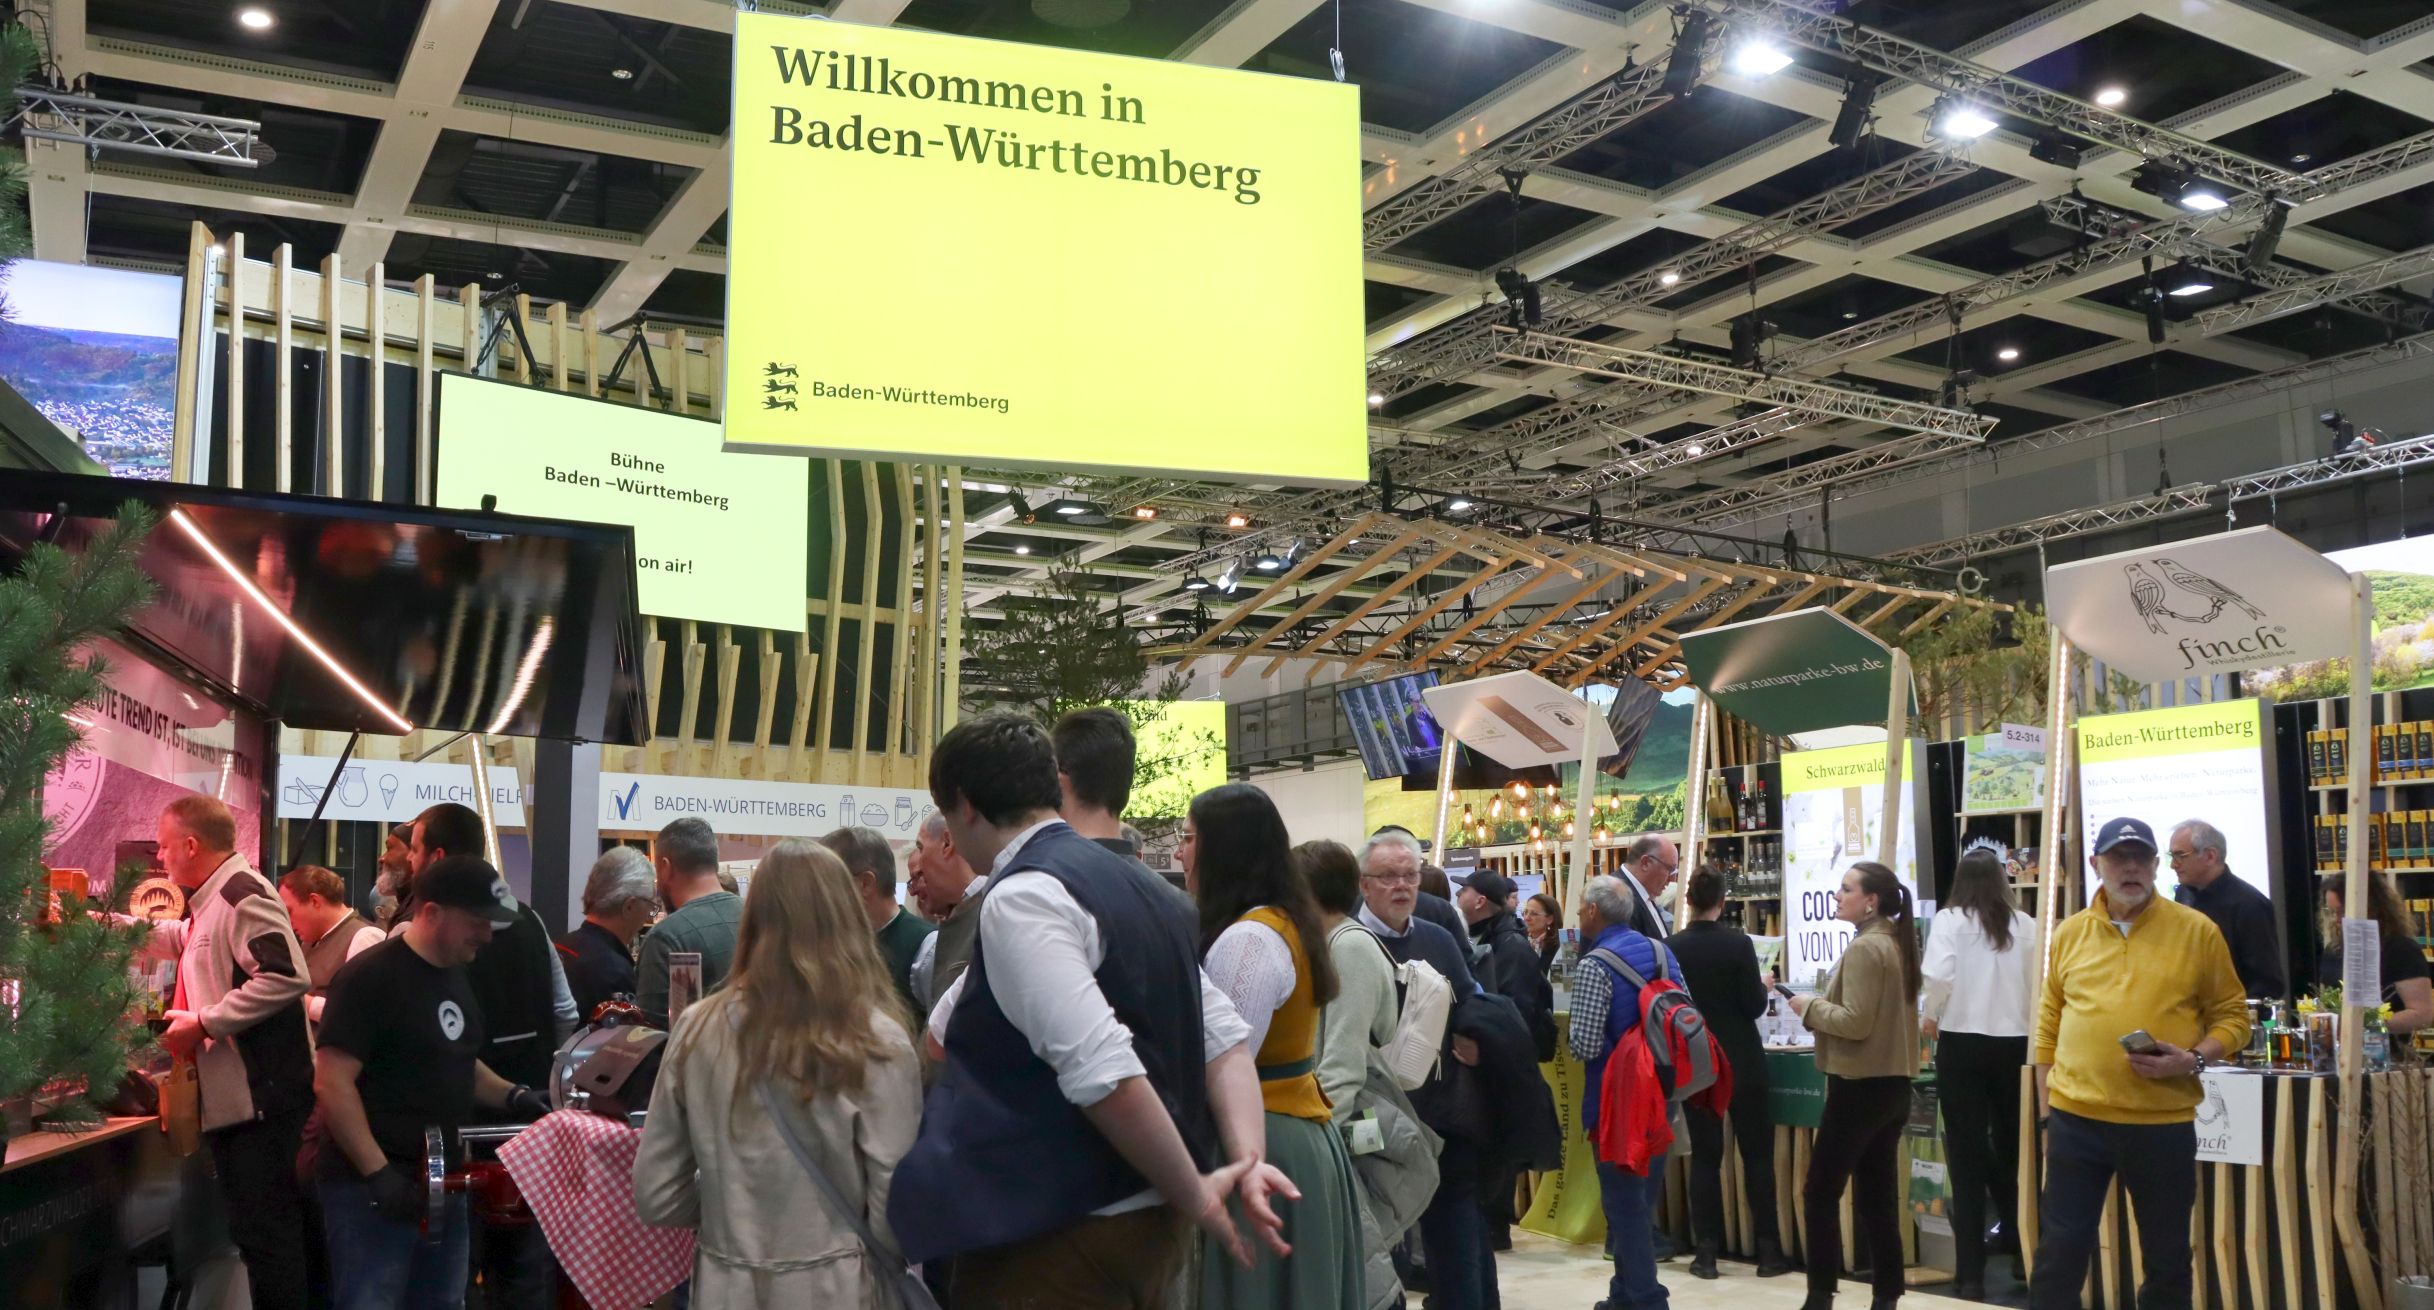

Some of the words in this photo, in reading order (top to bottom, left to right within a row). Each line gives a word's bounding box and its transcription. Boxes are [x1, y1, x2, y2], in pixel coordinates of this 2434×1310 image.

[771, 45, 1087, 118] Willkommen
[1099, 83, 1147, 125] in
[769, 105, 1262, 205] Baden-Württemberg
[812, 381, 1010, 414] Baden-Württemberg
[544, 466, 600, 488] Baden
[610, 452, 665, 473] Bühne
[638, 557, 660, 570] on
[664, 558, 693, 574] air!
[1715, 657, 1885, 696] www.naturparke-bw.de
[120, 692, 153, 735] TREND
[153, 709, 171, 750] IST,
[172, 719, 186, 751] IST
[2085, 720, 2254, 749] Baden-Württemberg
[2007, 730, 2041, 743] 5.2-314
[1806, 758, 1886, 779] Schwarzwald
[654, 795, 827, 818] BADEN-WÜRTTEMBERG
[1803, 890, 1836, 921] COC
[1799, 931, 1833, 962] VON
[1547, 1193, 1561, 1219] Das
